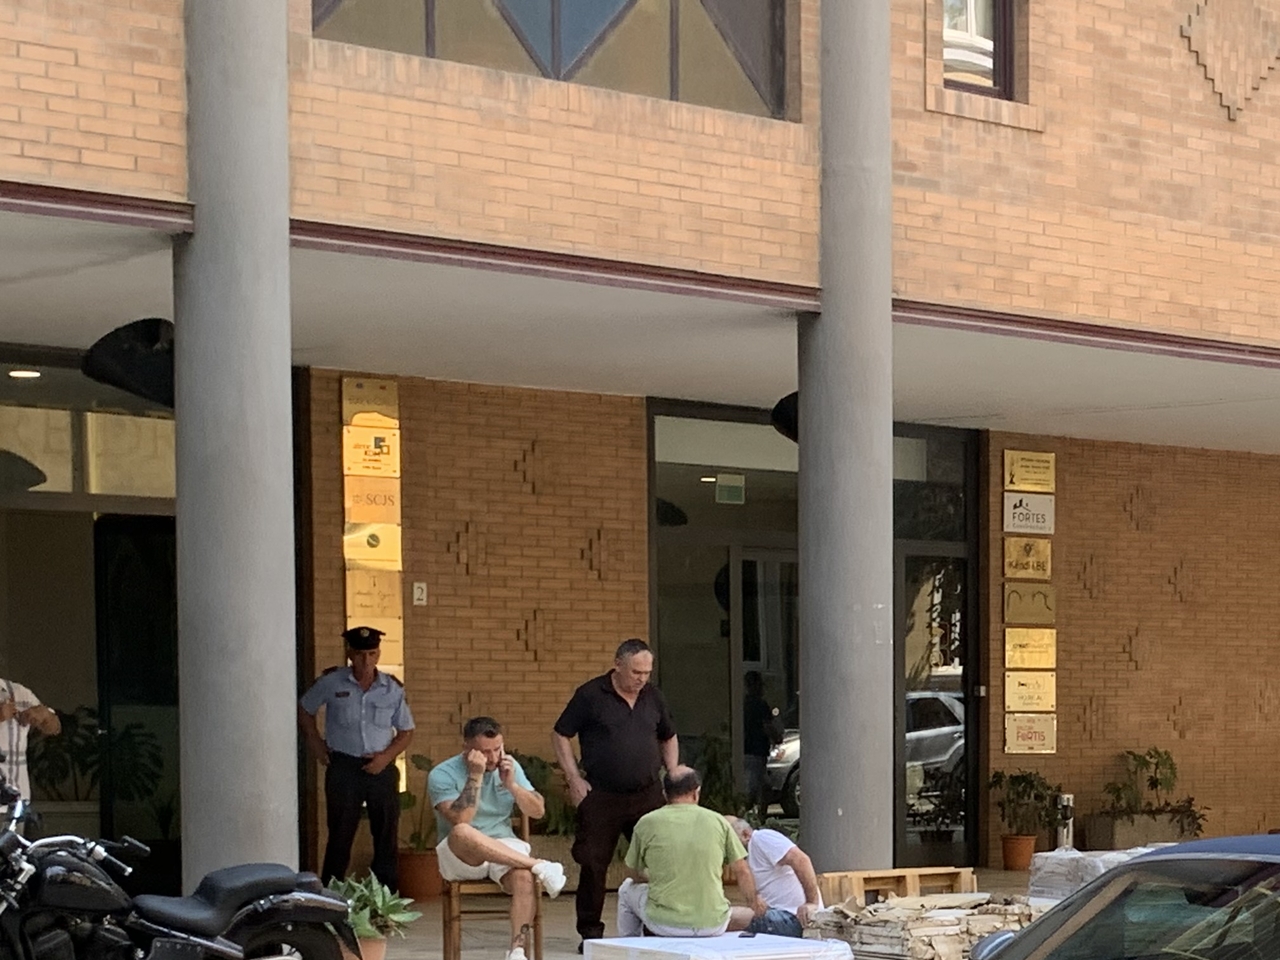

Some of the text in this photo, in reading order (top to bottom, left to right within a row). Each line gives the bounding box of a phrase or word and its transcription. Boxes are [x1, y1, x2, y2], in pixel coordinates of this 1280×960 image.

[366, 493, 395, 506] SCJS
[1012, 512, 1046, 524] FORTES
[416, 586, 424, 602] 2
